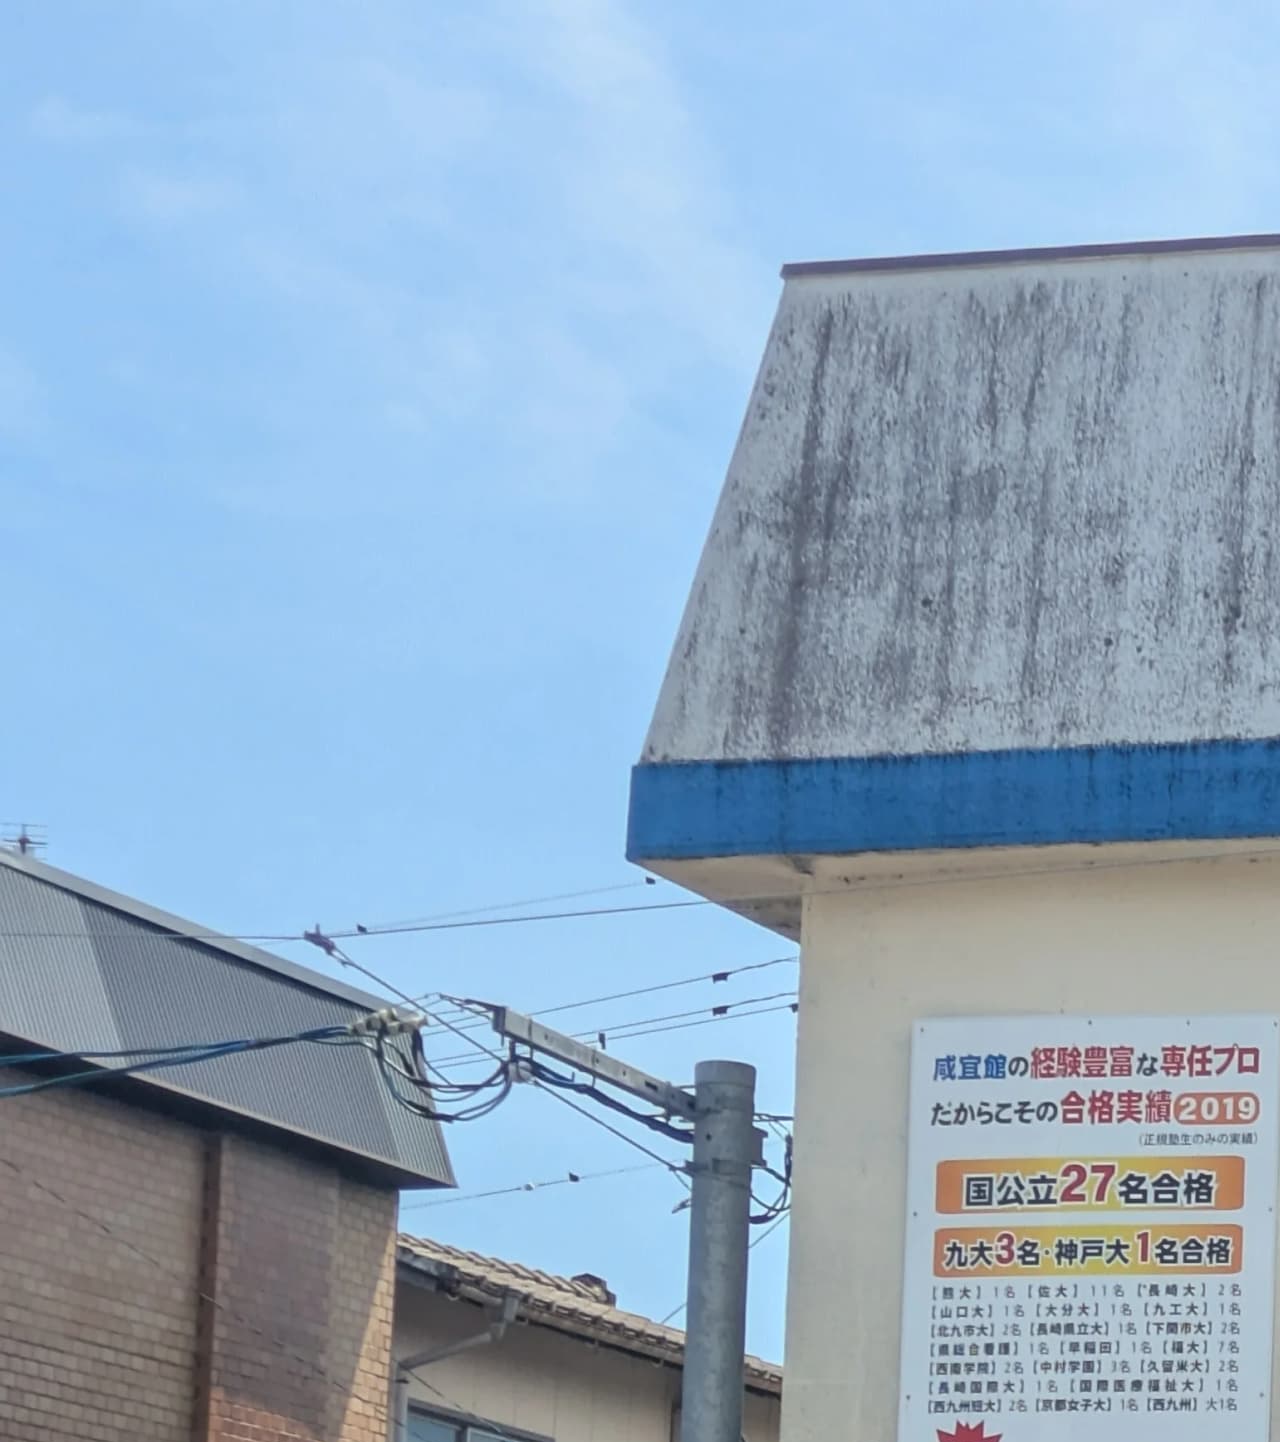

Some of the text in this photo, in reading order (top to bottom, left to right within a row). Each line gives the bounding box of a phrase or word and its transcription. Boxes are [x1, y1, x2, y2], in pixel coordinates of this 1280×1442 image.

[964, 1164, 1215, 1207] 国公立27名合格
